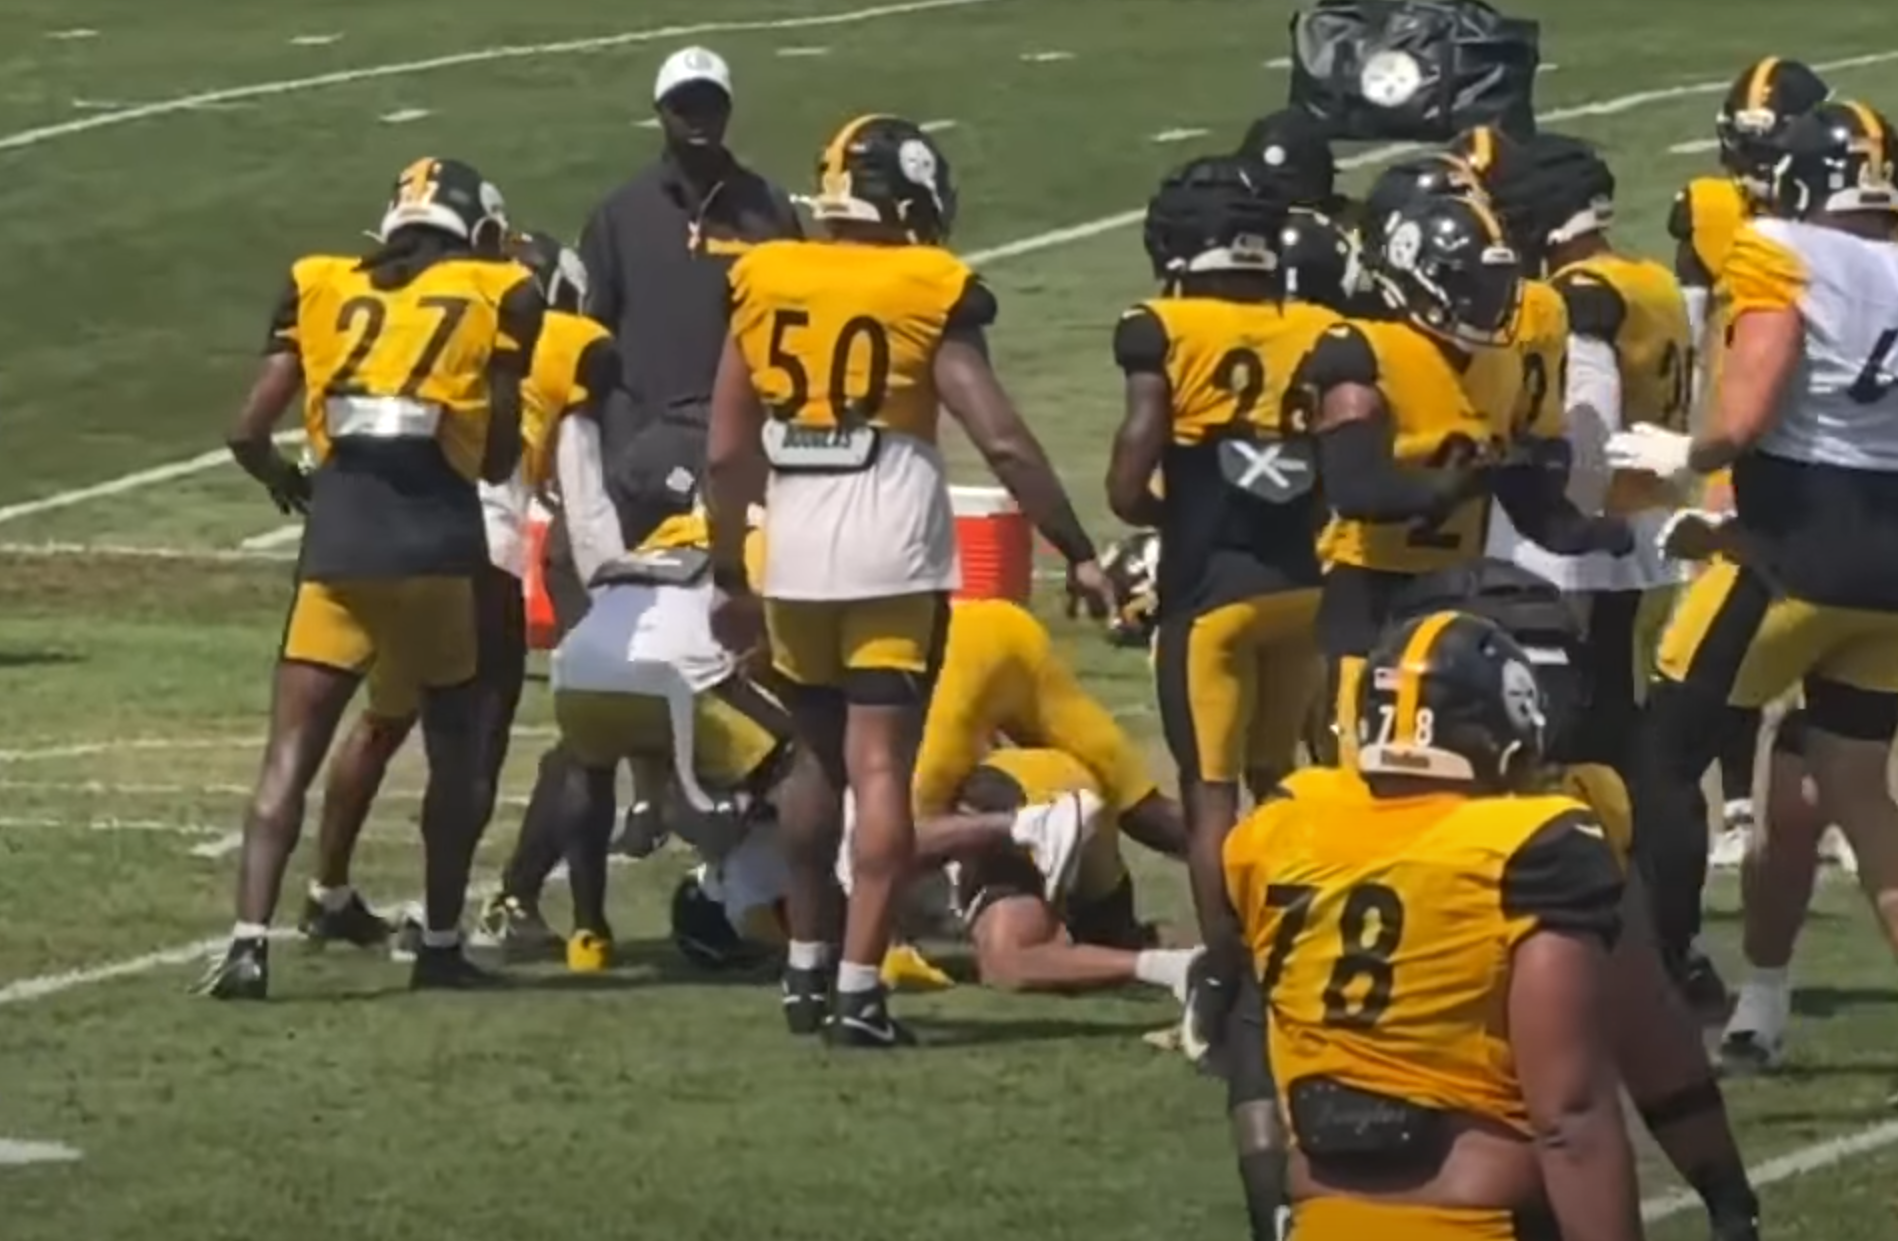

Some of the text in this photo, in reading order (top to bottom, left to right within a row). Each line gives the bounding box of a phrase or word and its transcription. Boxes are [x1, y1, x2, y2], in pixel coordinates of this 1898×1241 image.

[324, 296, 473, 396] 27
[769, 309, 891, 422] 50
[1377, 704, 1434, 747] 78
[1262, 883, 1405, 1027] 78
